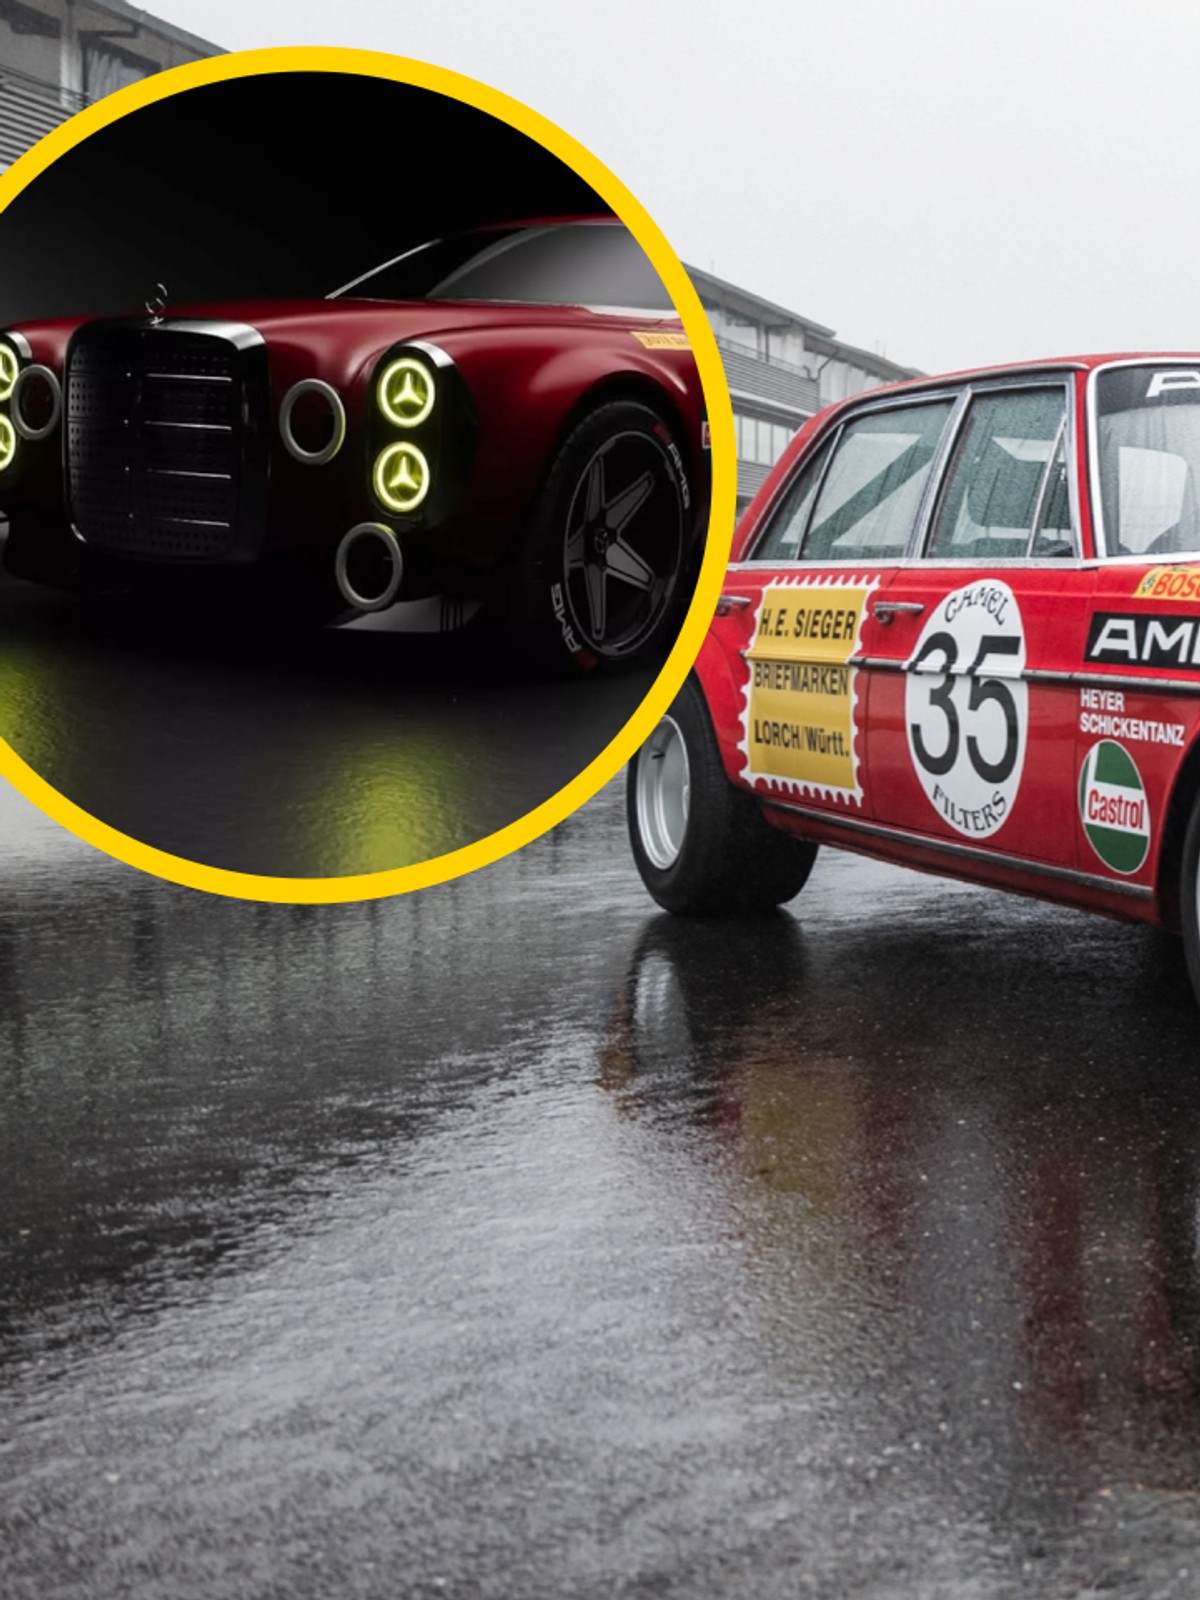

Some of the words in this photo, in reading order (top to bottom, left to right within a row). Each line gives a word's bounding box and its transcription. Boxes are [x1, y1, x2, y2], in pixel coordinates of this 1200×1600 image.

[668, 442, 690, 510] AMG
[551, 583, 581, 652] AMG
[759, 608, 789, 637] H.E.
[793, 609, 857, 640] SIEGER
[944, 586, 1009, 626] CAMEL
[755, 663, 849, 696] BRIEFMARKEN
[910, 631, 1022, 784] 35
[1080, 688, 1125, 712] HEYER
[1080, 712, 1185, 746] SCHICKENTANZ
[932, 783, 1007, 831] FILTERS
[1088, 789, 1145, 830] Castrol
